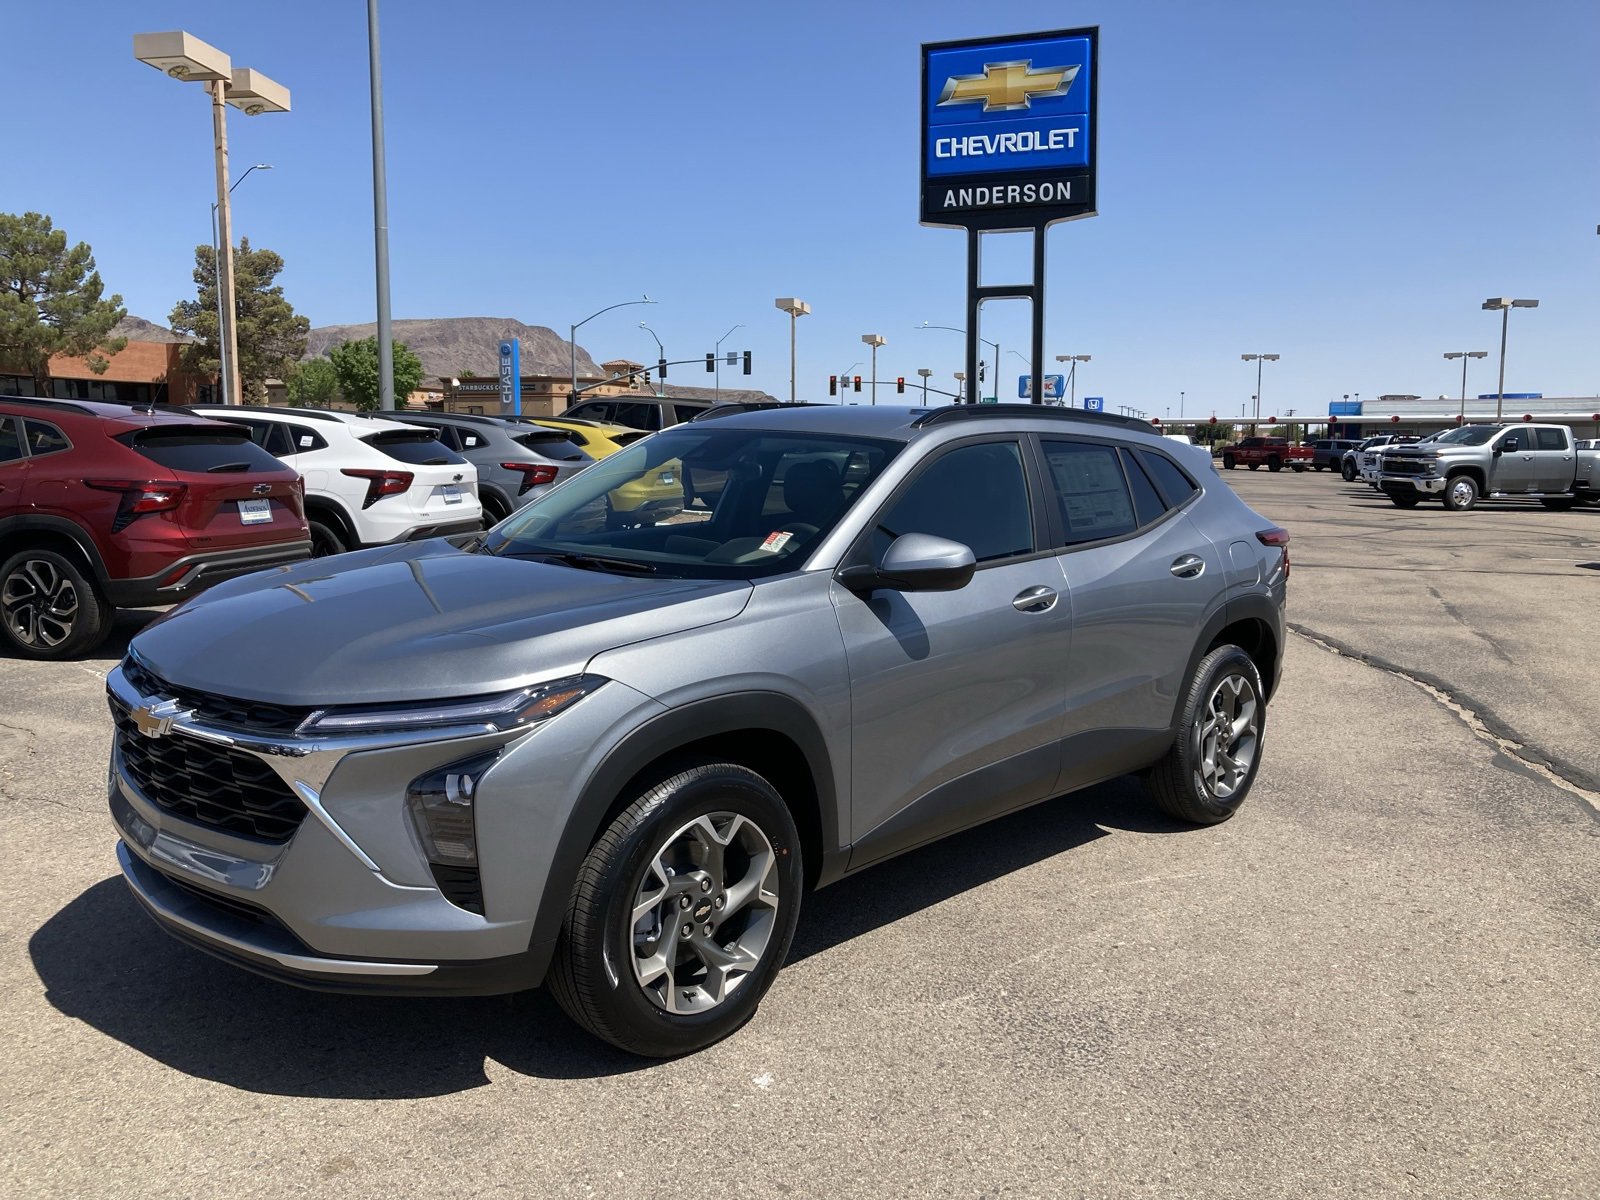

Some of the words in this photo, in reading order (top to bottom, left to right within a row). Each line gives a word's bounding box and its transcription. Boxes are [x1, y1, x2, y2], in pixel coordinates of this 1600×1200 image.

[935, 127, 1080, 158] CHEVROLET
[943, 181, 1071, 208] ANDERSON
[502, 357, 512, 404] CHASE
